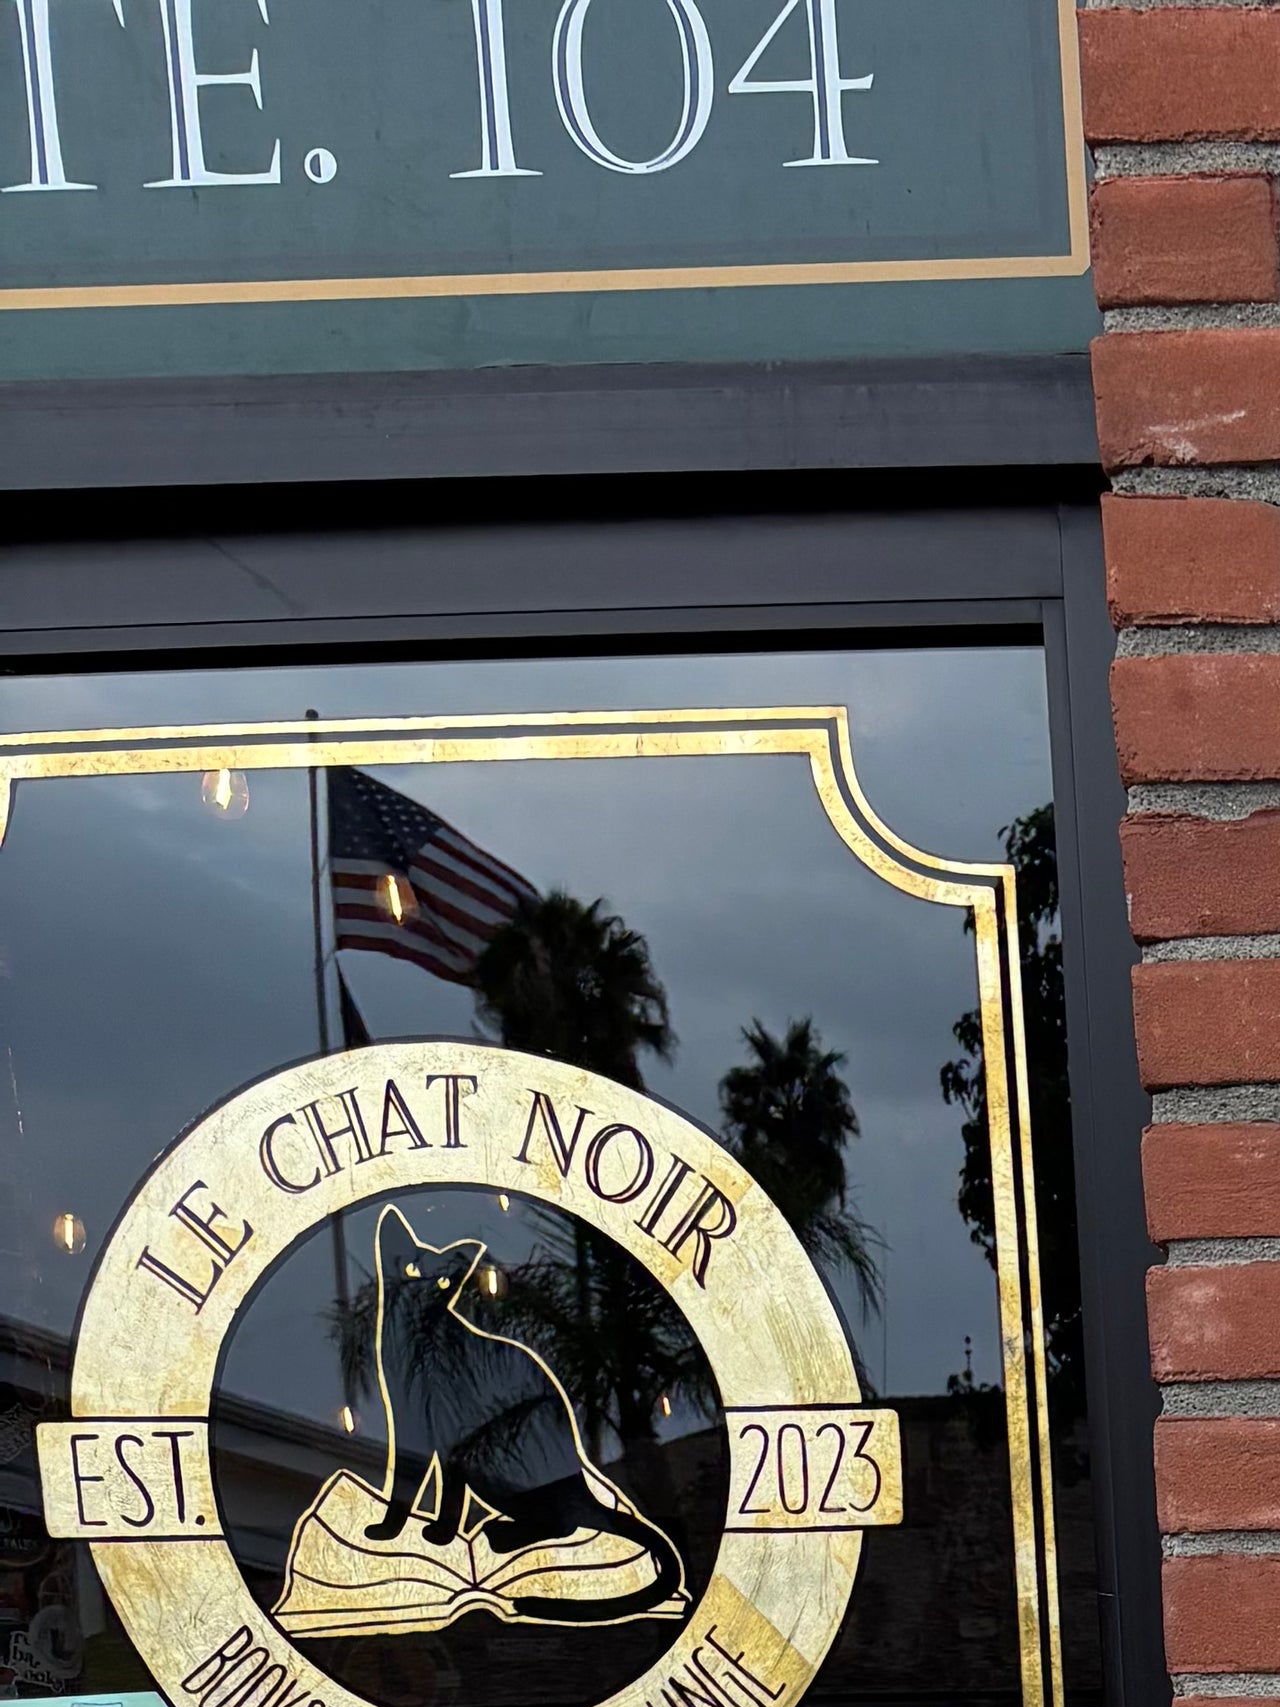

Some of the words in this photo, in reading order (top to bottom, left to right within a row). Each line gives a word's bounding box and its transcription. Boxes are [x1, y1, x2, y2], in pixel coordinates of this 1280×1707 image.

[450, 0, 880, 178] 104
[135, 1178, 256, 1317] LE
[258, 1074, 478, 1196] CHAT
[516, 1088, 740, 1289] NOIR
[71, 1431, 205, 1528] EST.
[738, 1421, 882, 1516] 2023
